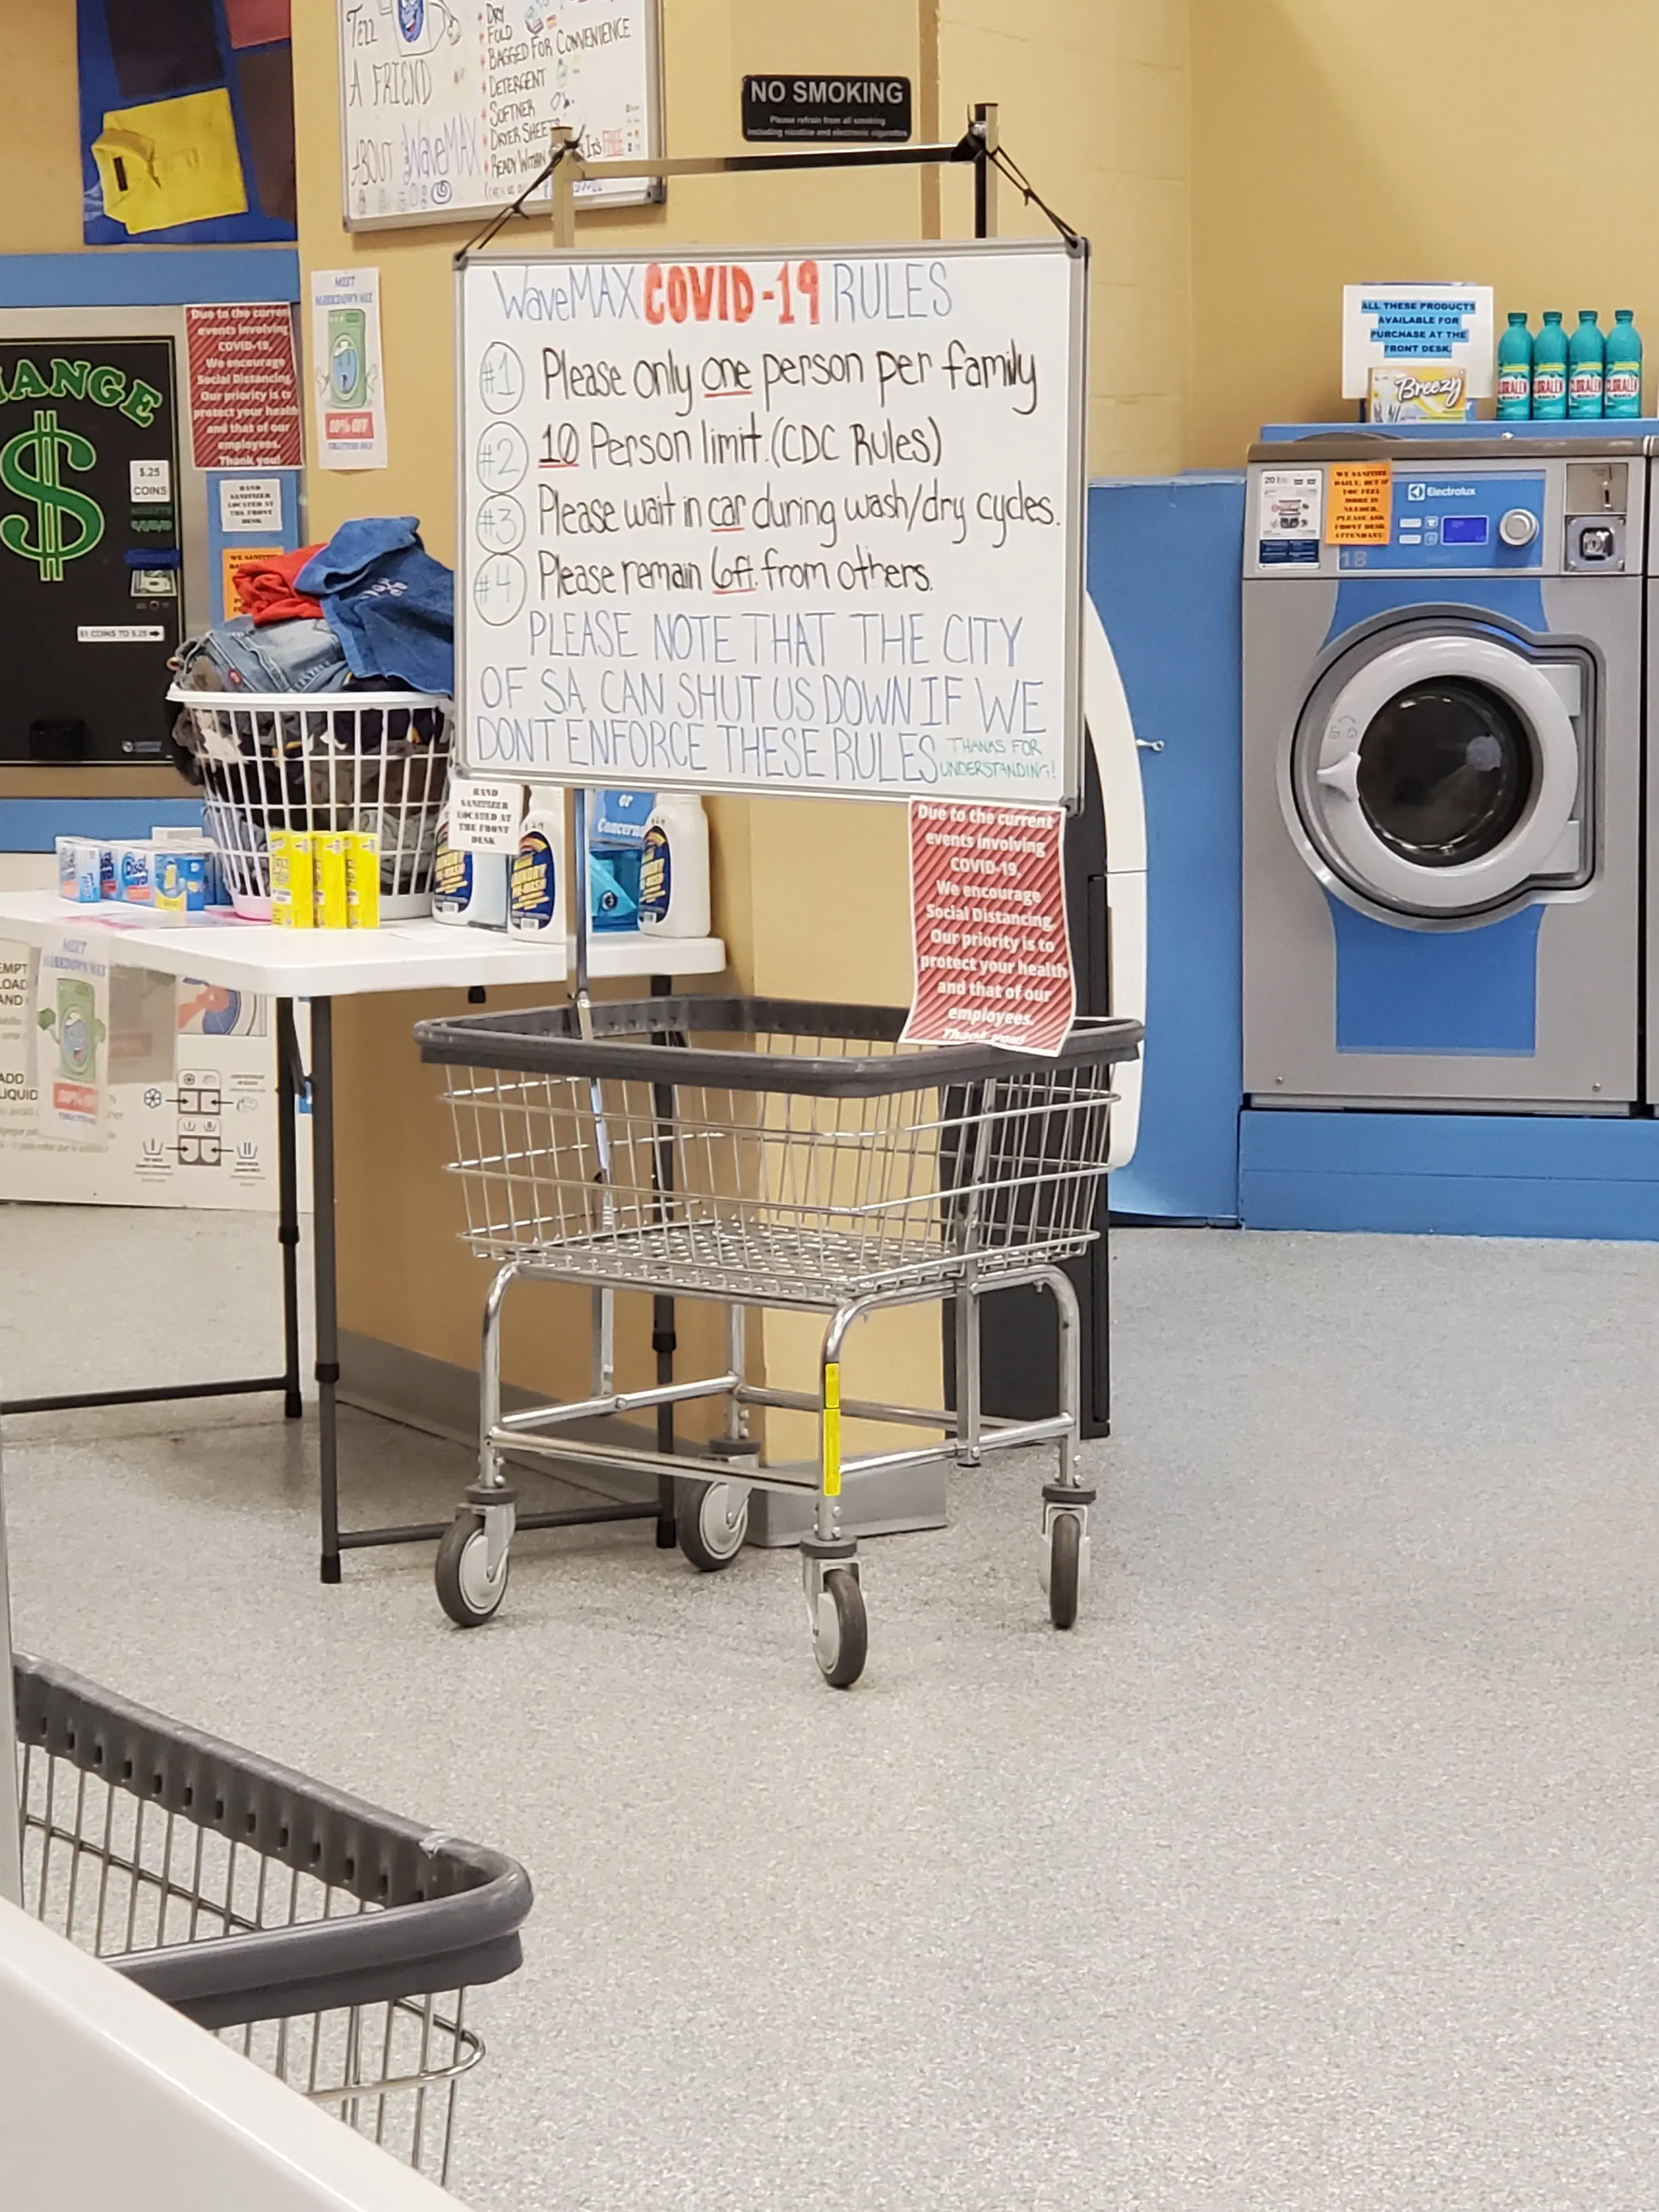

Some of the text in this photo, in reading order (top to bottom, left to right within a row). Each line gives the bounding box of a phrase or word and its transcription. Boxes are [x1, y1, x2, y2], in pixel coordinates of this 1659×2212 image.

[487, 25, 513, 44] FOLD
[349, 58, 432, 107] A FRIEND
[489, 68, 547, 99] DETERGENT
[751, 81, 903, 104] NO SMOKING
[489, 99, 535, 127] SOFTNER
[493, 260, 953, 325] WaveMAX COVID-19 RULES
[191, 309, 215, 319] Due
[216, 309, 229, 318] to
[231, 309, 250, 318] the
[198, 326, 236, 336] events
[206, 358, 286, 369] We encourage
[197, 373, 230, 384] Social
[481, 338, 1037, 416] #1 Please only one person per family
[0, 359, 163, 427] ANGE
[201, 391, 222, 402] Our
[224, 390, 267, 402] priority
[1395, 376, 1463, 408] Breezy
[237, 408, 263, 419] your
[206, 421, 290, 434] and that of our
[479, 438, 519, 477] #2
[539, 422, 579, 465] 10
[590, 421, 691, 470] Person
[771, 416, 839, 469] (CDC
[850, 416, 942, 467] Rules)
[219, 455, 255, 466] Thank
[1265, 476, 1275, 484] 20
[134, 486, 166, 495] COINS
[1427, 486, 1476, 497] Electrolux
[478, 477, 1062, 549] #3 Please wait in car during wash/dry cycles.
[1341, 550, 1367, 567] 18
[475, 564, 511, 603] #4
[538, 550, 617, 601] Please
[621, 559, 703, 595] remain
[761, 547, 831, 591] from
[837, 544, 934, 591] others.
[530, 610, 1023, 667] PLEASE NOTE THAT THE CITY
[480, 666, 527, 709] OF
[601, 669, 664, 716] CAN
[678, 673, 761, 724] SHUT
[772, 676, 815, 721] US
[822, 674, 912, 726] DOWN
[920, 675, 963, 726] IF
[975, 677, 1047, 735] WE
[476, 716, 1043, 783] DONT ENFORCE THESE RULES THANKS FOR
[939, 760, 1057, 781] UNDERSTANDING!
[473, 788, 498, 797] HAND
[457, 811, 497, 821] LOCATED
[918, 804, 1054, 830] Due to the current
[459, 823, 509, 834] THE FRONT
[471, 836, 495, 844] DESK
[925, 832, 1046, 858] events involving
[936, 880, 1042, 907] We encourage
[926, 904, 969, 922] Social
[930, 929, 1055, 954] Our priority is to
[0, 963, 28, 974] EMPT
[920, 955, 1068, 980] protect your health
[0, 979, 27, 990] OAD
[937, 980, 1052, 1003] and that of our
[947, 1007, 1035, 1027] employees.
[941, 1027, 1026, 1045] Thank you!
